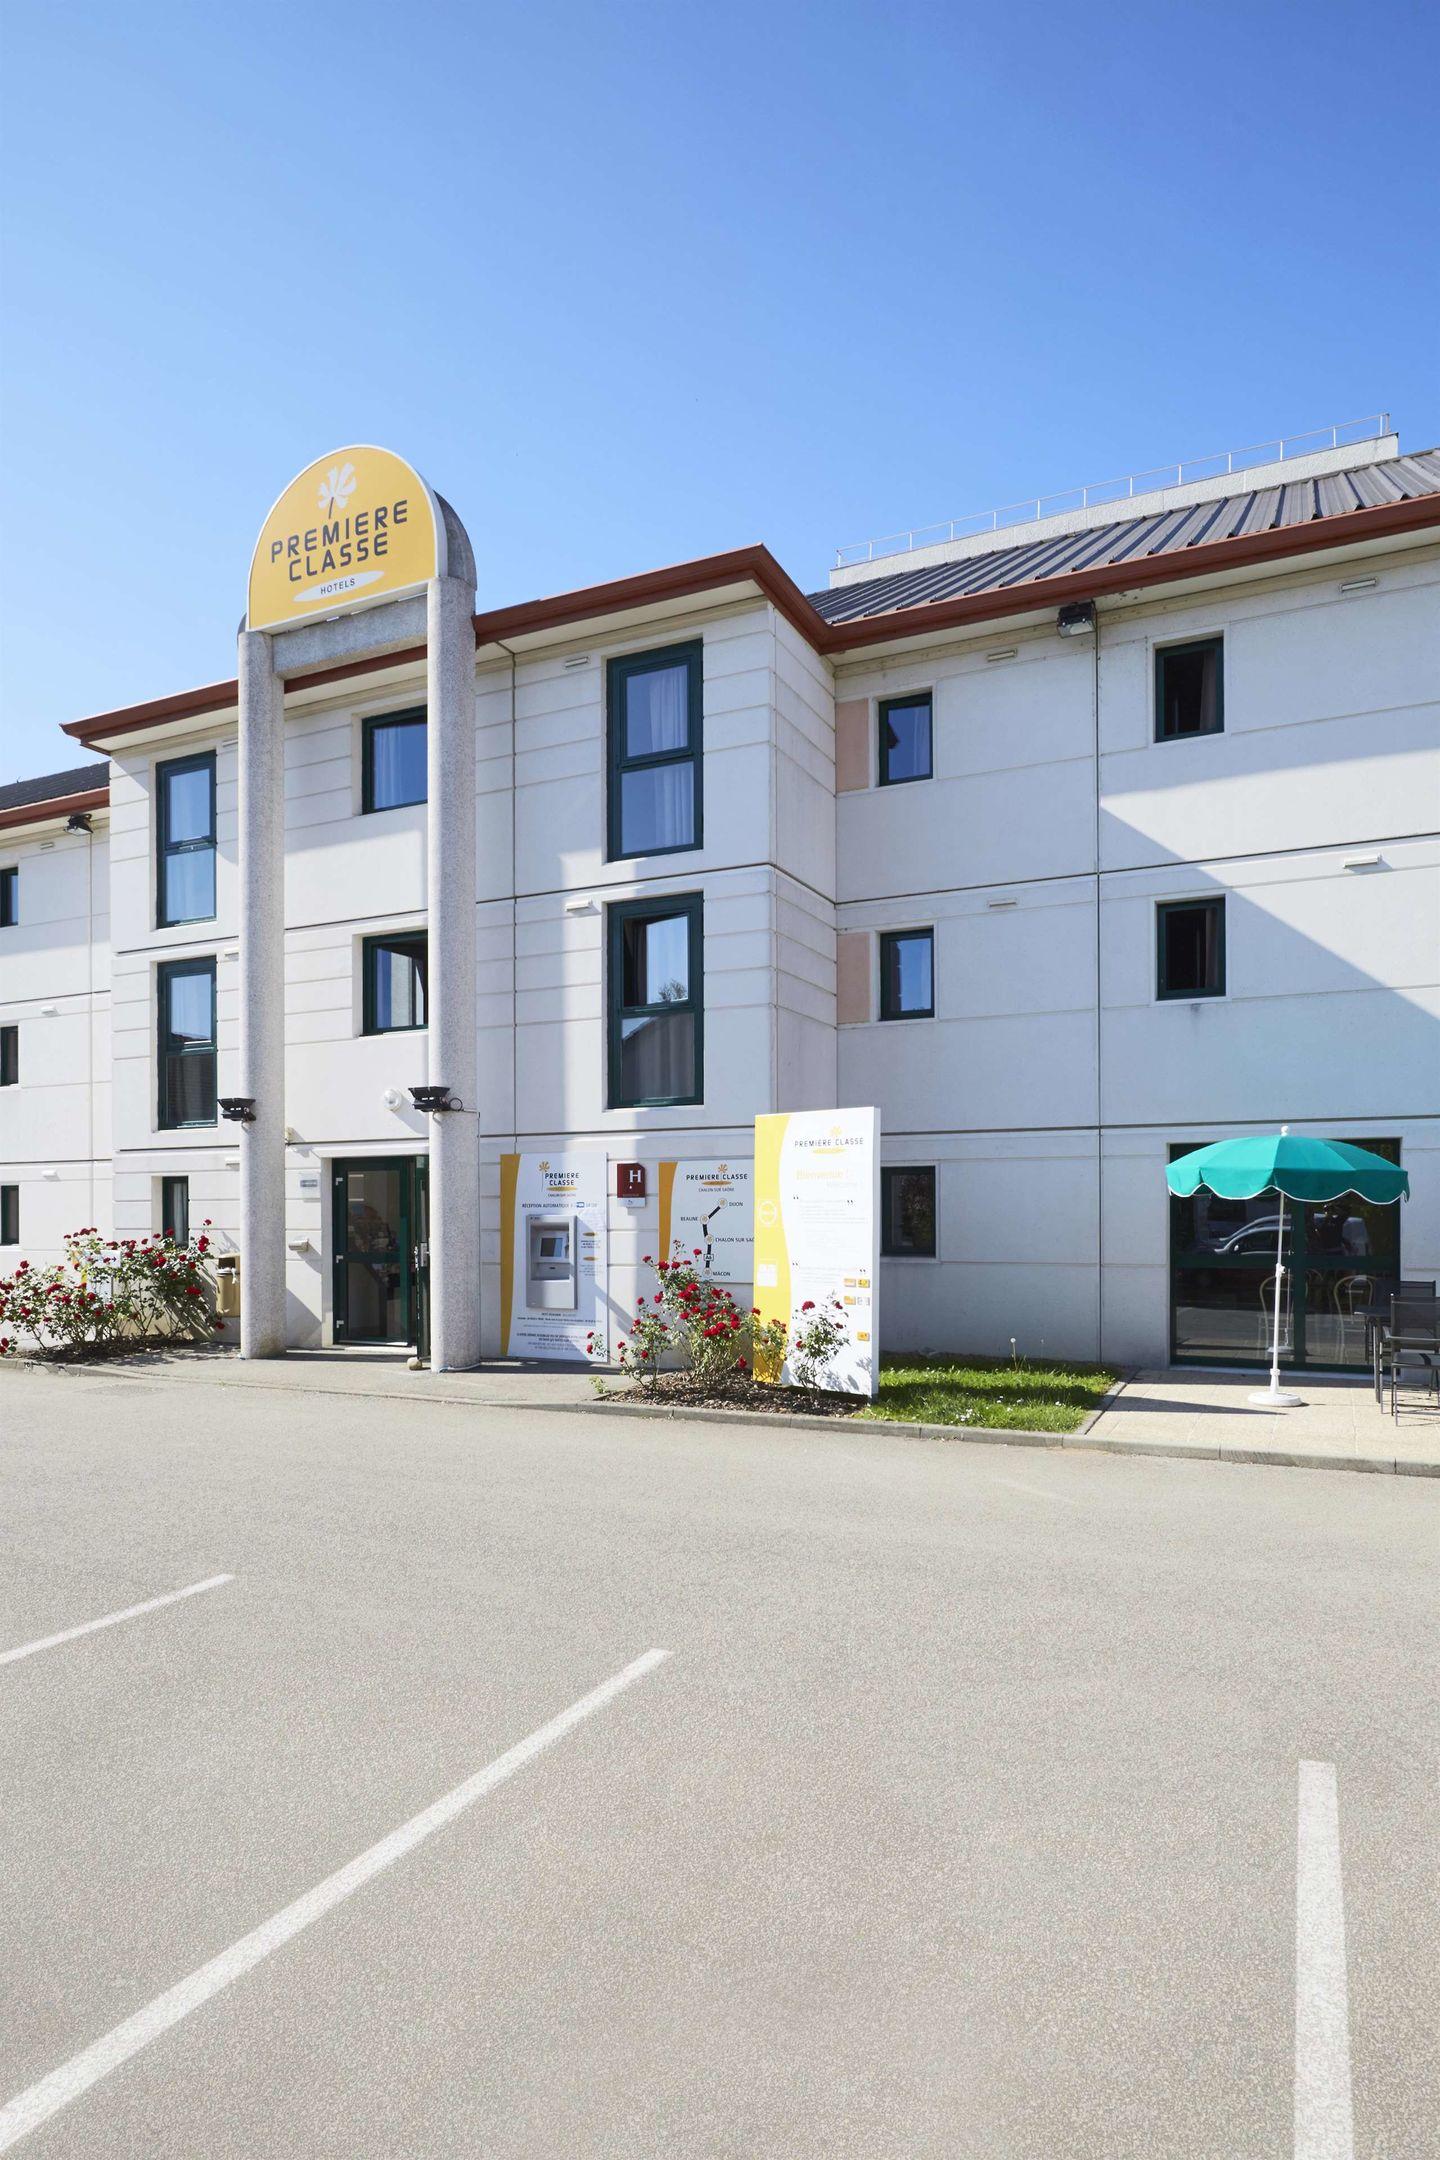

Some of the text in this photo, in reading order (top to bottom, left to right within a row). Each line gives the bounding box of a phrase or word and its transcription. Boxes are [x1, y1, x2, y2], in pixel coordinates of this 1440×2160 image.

[271, 500, 408, 563] PREMIERE
[289, 532, 388, 582] CLASSE
[320, 578, 356, 595] HOTELS
[794, 1138, 864, 1148] PREMIERE CLASSE
[629, 1170, 642, 1183] H
